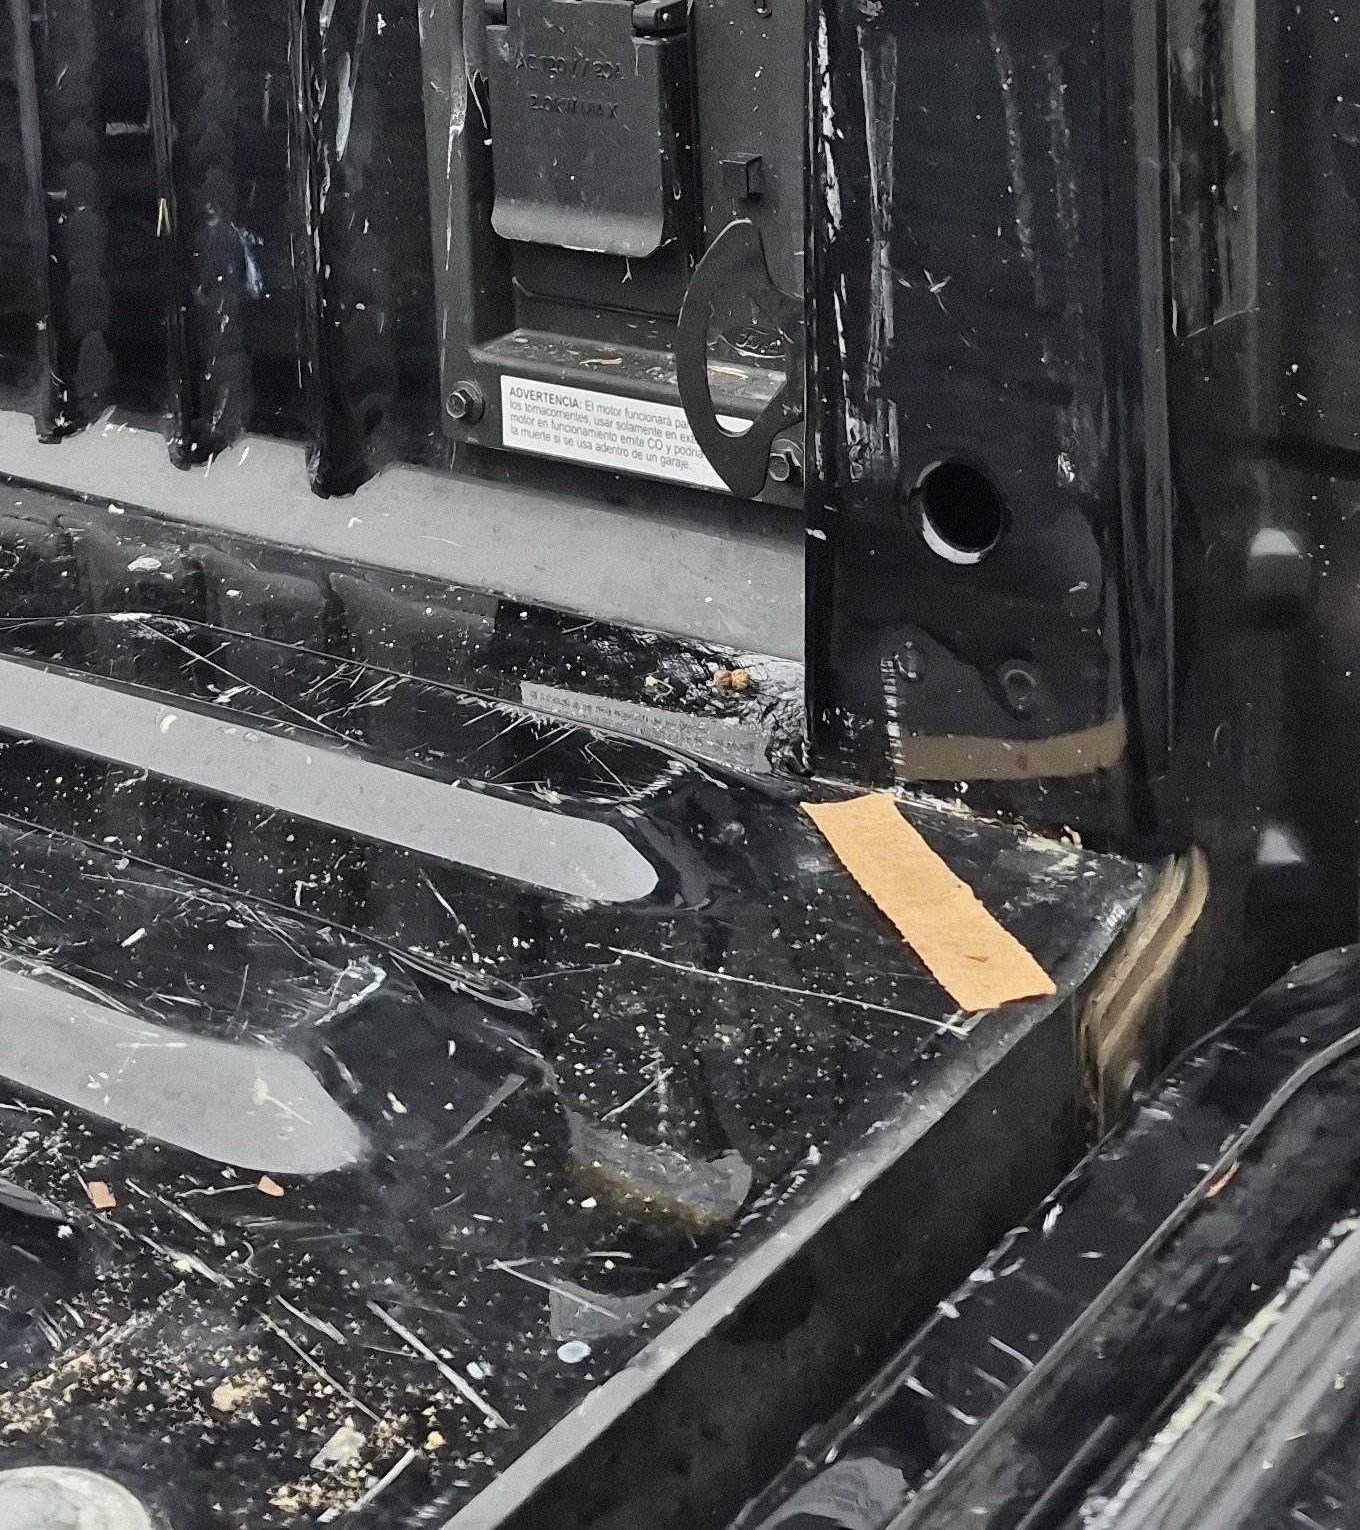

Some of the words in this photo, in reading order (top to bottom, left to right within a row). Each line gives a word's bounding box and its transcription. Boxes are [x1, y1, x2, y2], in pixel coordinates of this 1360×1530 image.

[509, 387, 582, 409] ADVERTENCIA:
[585, 400, 594, 411] El
[597, 404, 622, 417] motor
[510, 399, 522, 411] los
[594, 417, 613, 429] usar
[616, 421, 662, 437] solamente
[665, 430, 677, 440] en
[510, 414, 535, 426] motor
[537, 419, 548, 429] en
[551, 419, 617, 442] funcionamiento
[620, 435, 645, 448] emite
[647, 437, 663, 451] CO
[666, 444, 671, 455] y
[510, 424, 518, 436] la
[521, 428, 551, 442] muerte
[554, 433, 560, 443] si
[563, 436, 574, 447] se
[577, 439, 592, 449] usa
[595, 442, 629, 457] adentro
[632, 449, 643, 460] de
[646, 453, 657, 463] un
[660, 456, 692, 470] garaje.
